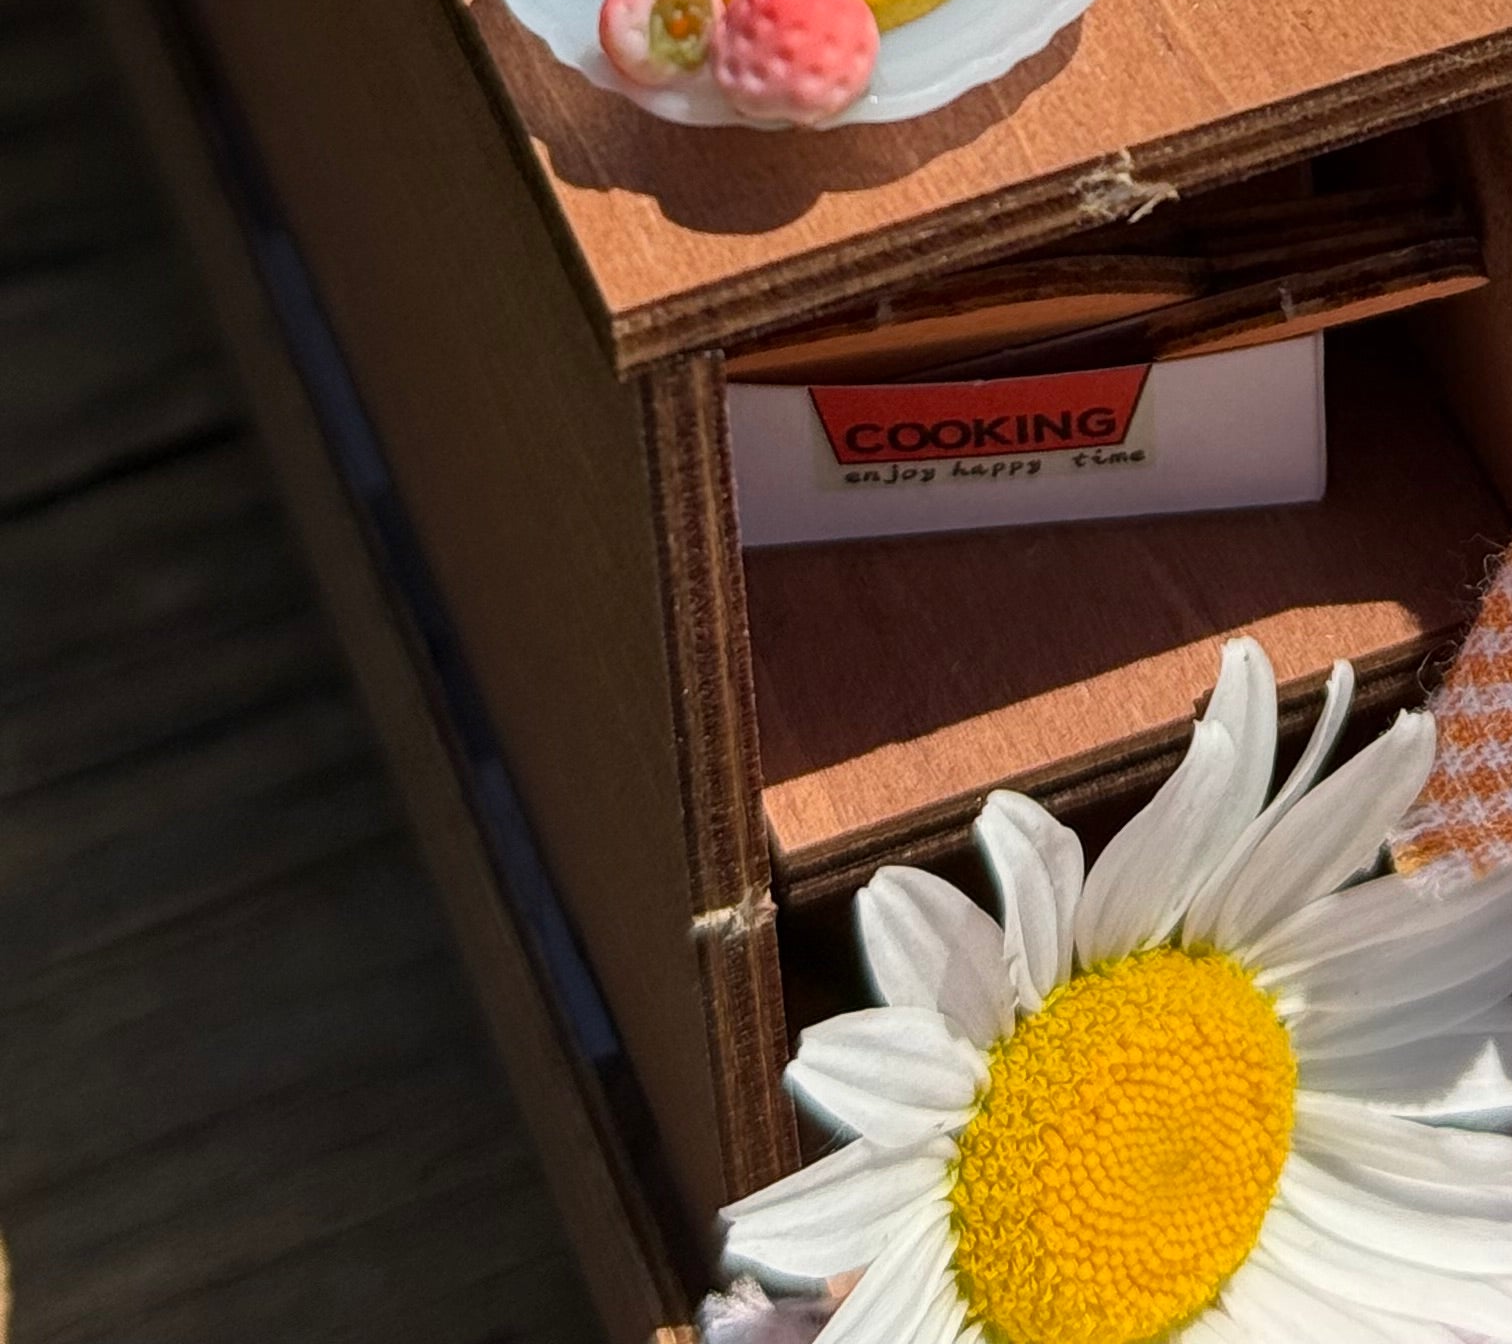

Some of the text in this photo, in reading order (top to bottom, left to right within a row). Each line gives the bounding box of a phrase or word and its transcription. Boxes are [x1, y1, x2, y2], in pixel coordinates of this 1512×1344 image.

[844, 407, 1117, 454] COOKING
[844, 447, 1146, 484] enjoy happy time
